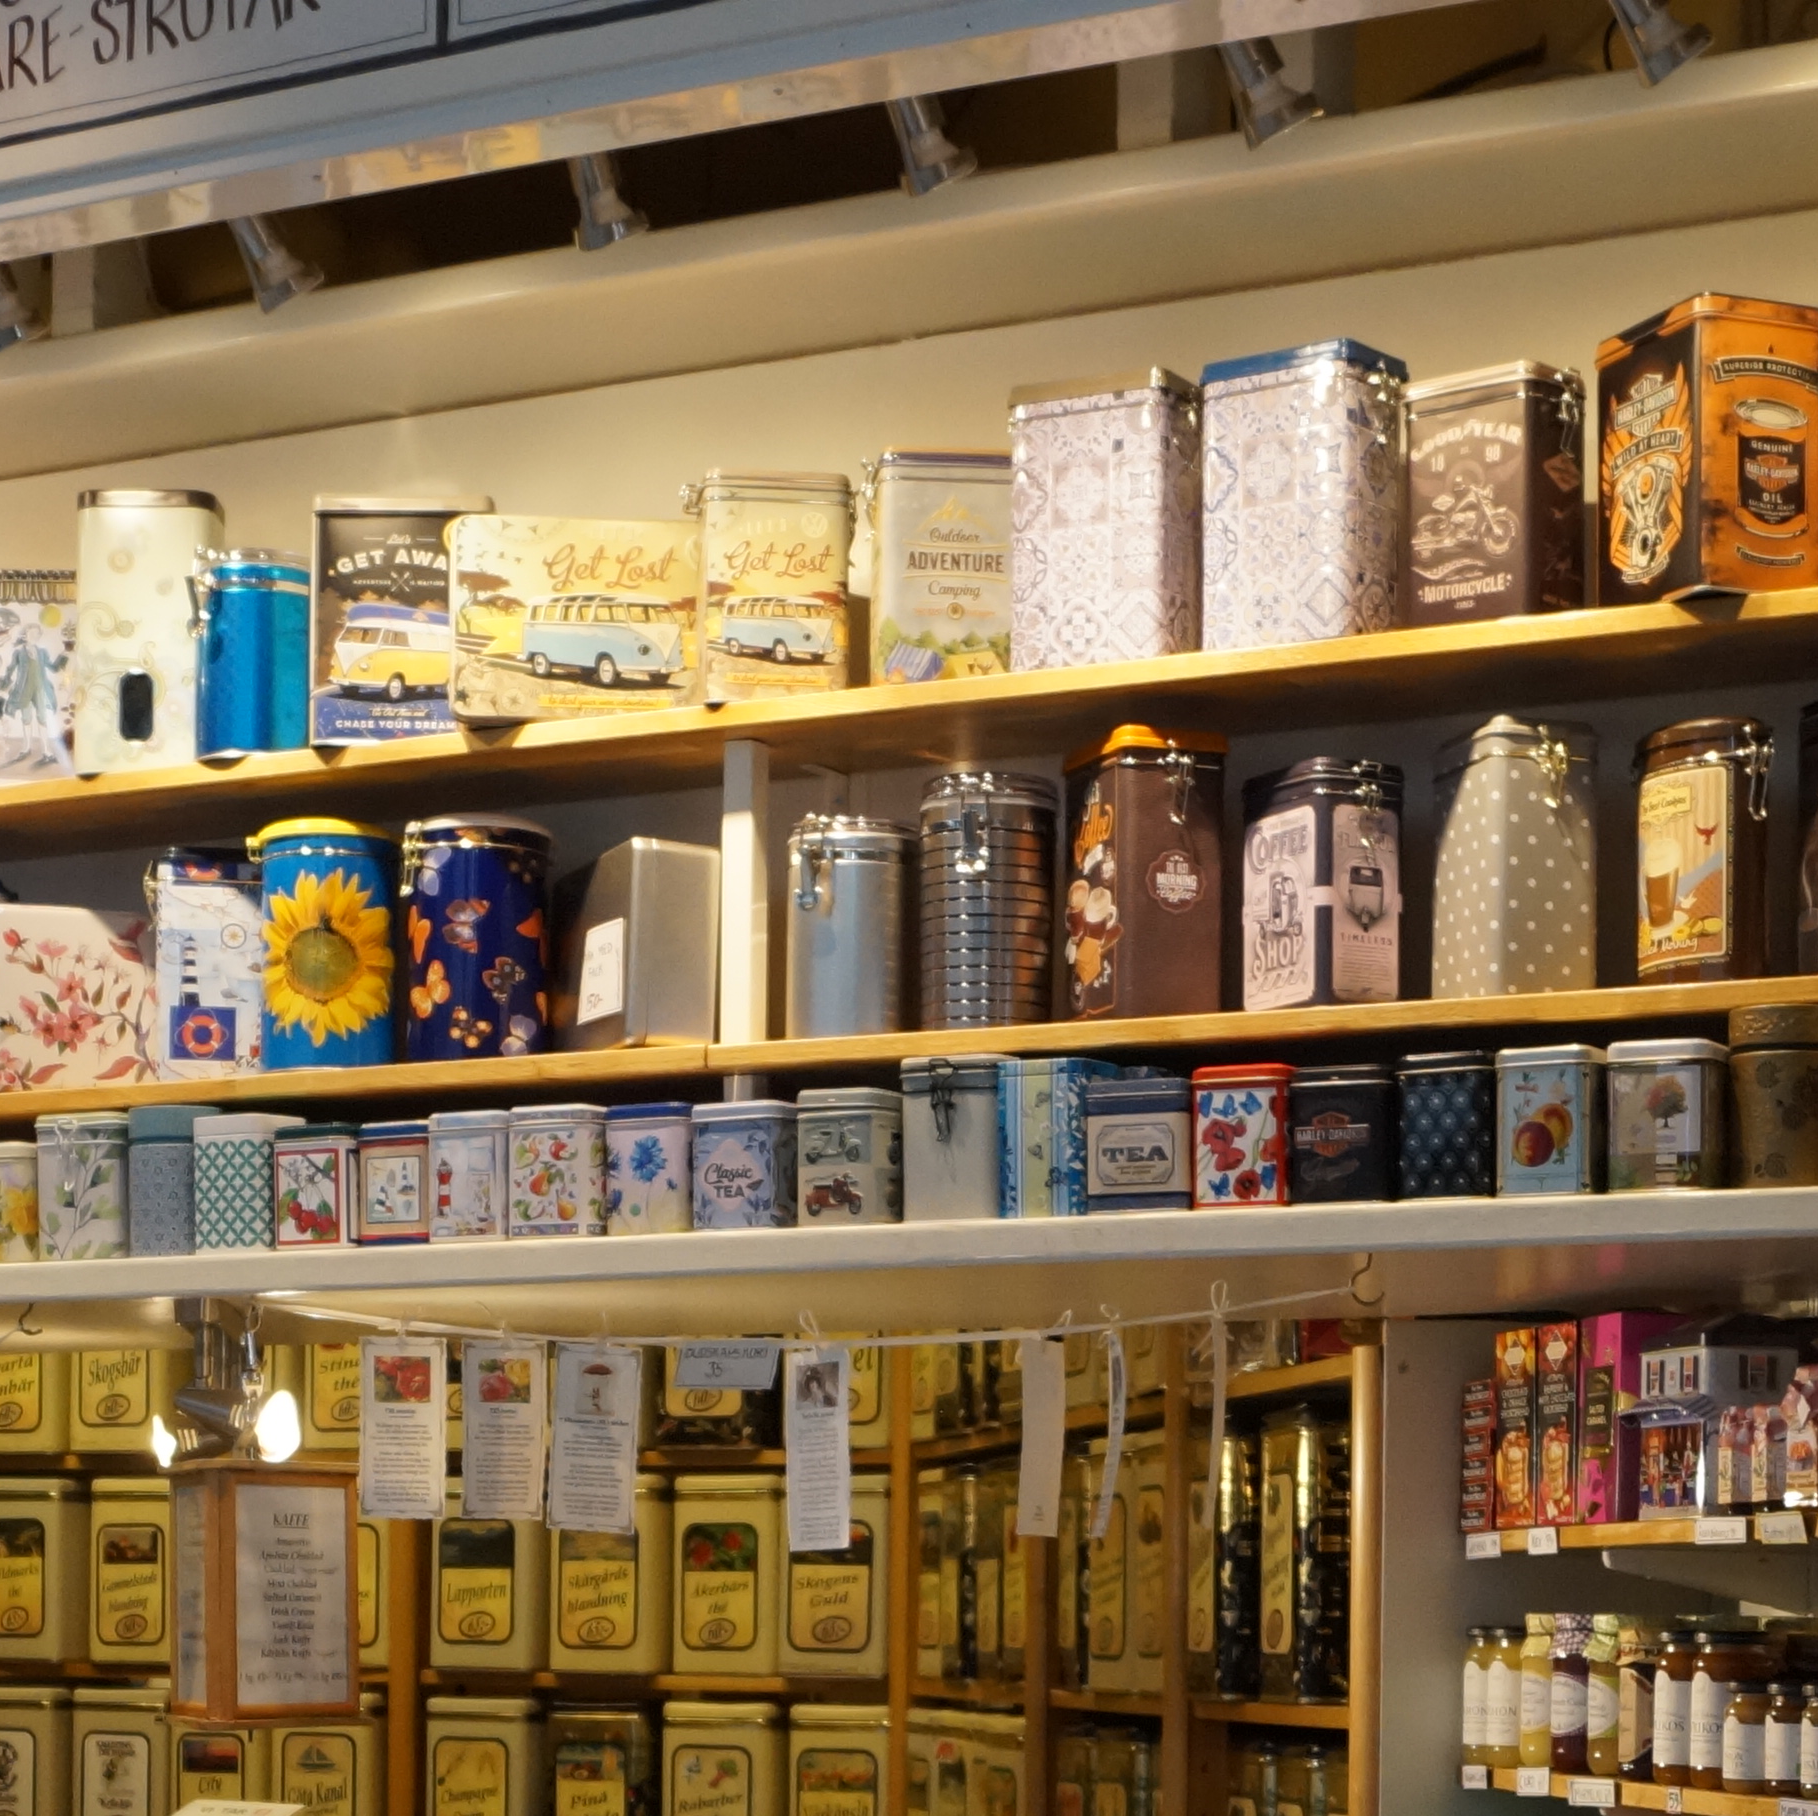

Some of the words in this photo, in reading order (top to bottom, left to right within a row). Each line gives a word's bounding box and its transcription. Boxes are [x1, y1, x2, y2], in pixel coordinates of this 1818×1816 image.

[1723, 361, 1764, 373] SUPERIOR
[1614, 447, 1636, 468] WILD
[1638, 442, 1649, 454] AT
[1649, 431, 1676, 449] HEART
[1750, 440, 1793, 453] GENUINE
[1762, 492, 1783, 504] OIL
[929, 526, 981, 544] Outdoor
[334, 549, 385, 575] GET
[393, 547, 449, 572] AWA
[542, 542, 610, 591] Get
[604, 545, 679, 591] Lost
[722, 540, 777, 581] Get
[774, 541, 835, 579] Lost
[906, 550, 1005, 574] ADVENTURE
[927, 579, 982, 600] Camping
[1423, 572, 1506, 604] MOTORCYCLE
[334, 719, 377, 731] CHASE
[378, 719, 412, 731] YOUR
[1248, 826, 1308, 875] COFFEE
[1155, 872, 1198, 888] MORNING
[1252, 931, 1305, 980] SHOP
[1101, 1145, 1169, 1164] TEA
[704, 1163, 754, 1185] Classic
[713, 1184, 745, 1199] TEA
[446, 1581, 507, 1608] Lapporten
